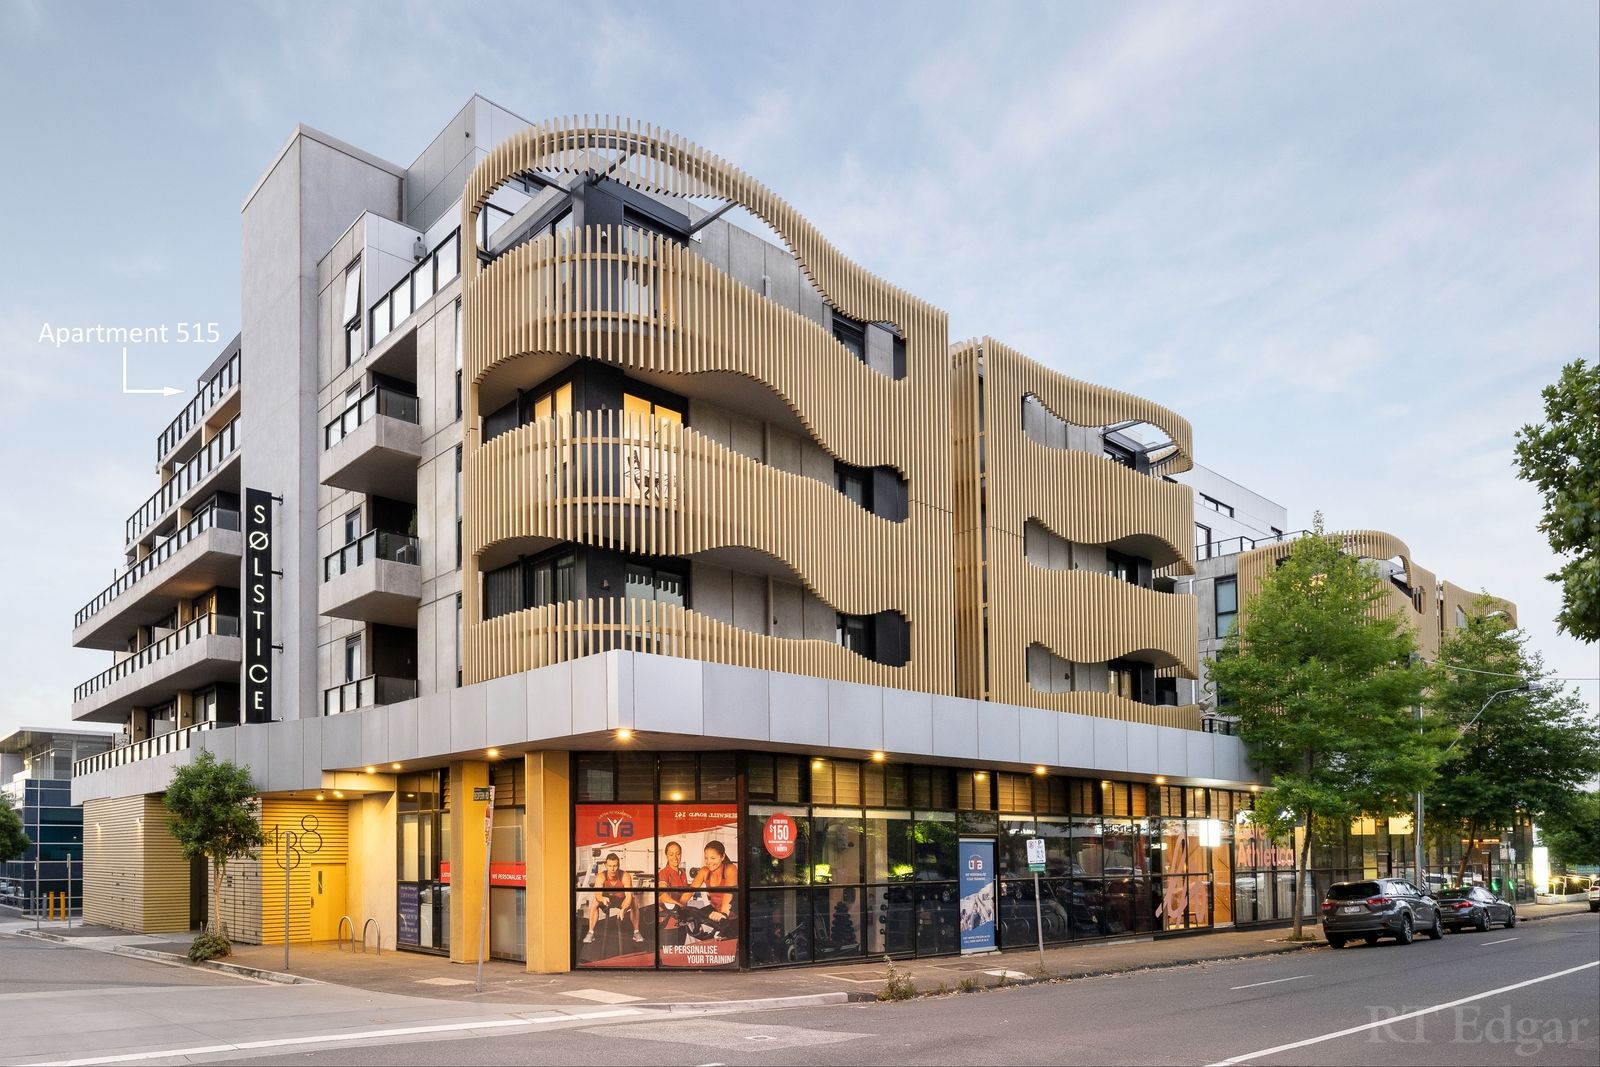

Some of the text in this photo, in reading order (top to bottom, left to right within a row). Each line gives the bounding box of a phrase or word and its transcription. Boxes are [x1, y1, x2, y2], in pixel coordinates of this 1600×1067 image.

[248, 504, 269, 710] SØLSTICE
[266, 814, 323, 870] 138
[770, 825, 789, 840] $150
[1237, 840, 1294, 867] Athletica
[662, 945, 718, 954] WE PERSONALISE
[687, 955, 736, 964] YOUR TRAINING
